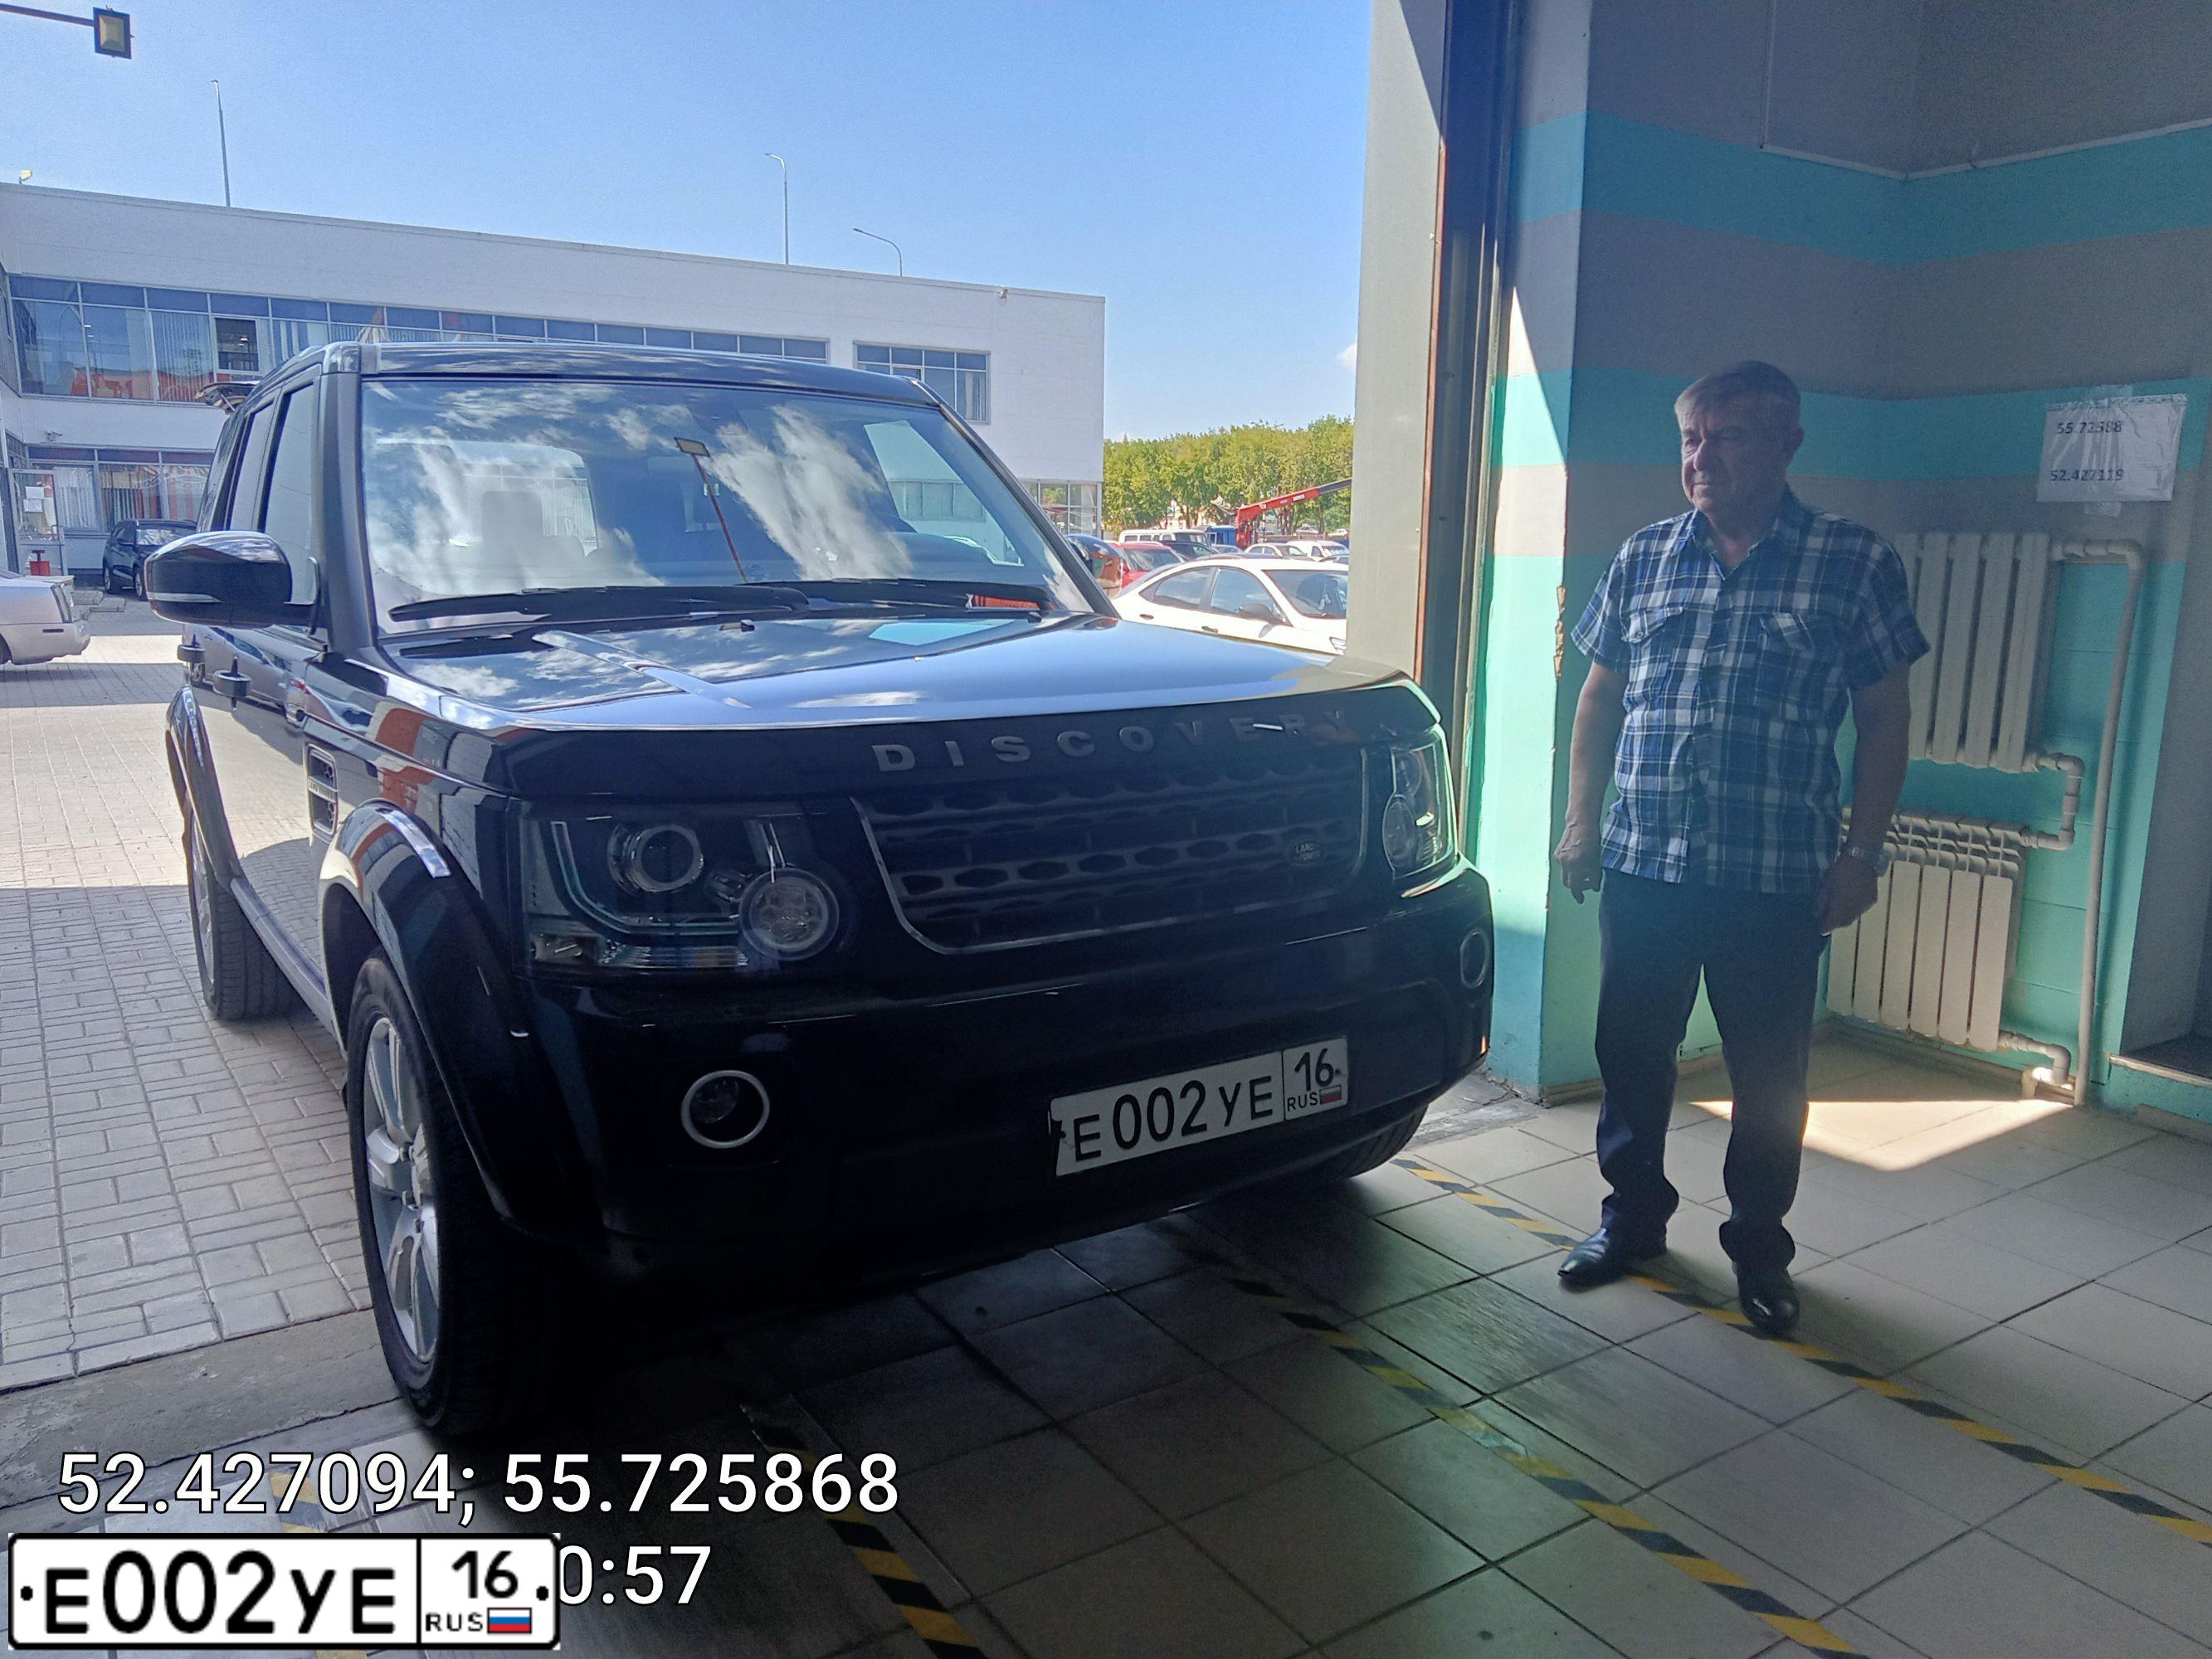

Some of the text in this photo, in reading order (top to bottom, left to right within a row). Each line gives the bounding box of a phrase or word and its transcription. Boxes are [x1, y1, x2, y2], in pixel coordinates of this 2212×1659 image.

[871, 709, 1345, 772] DISCOVERY
[1294, 1048, 1333, 1092] 16
[1287, 1092, 1318, 1112] RUS
